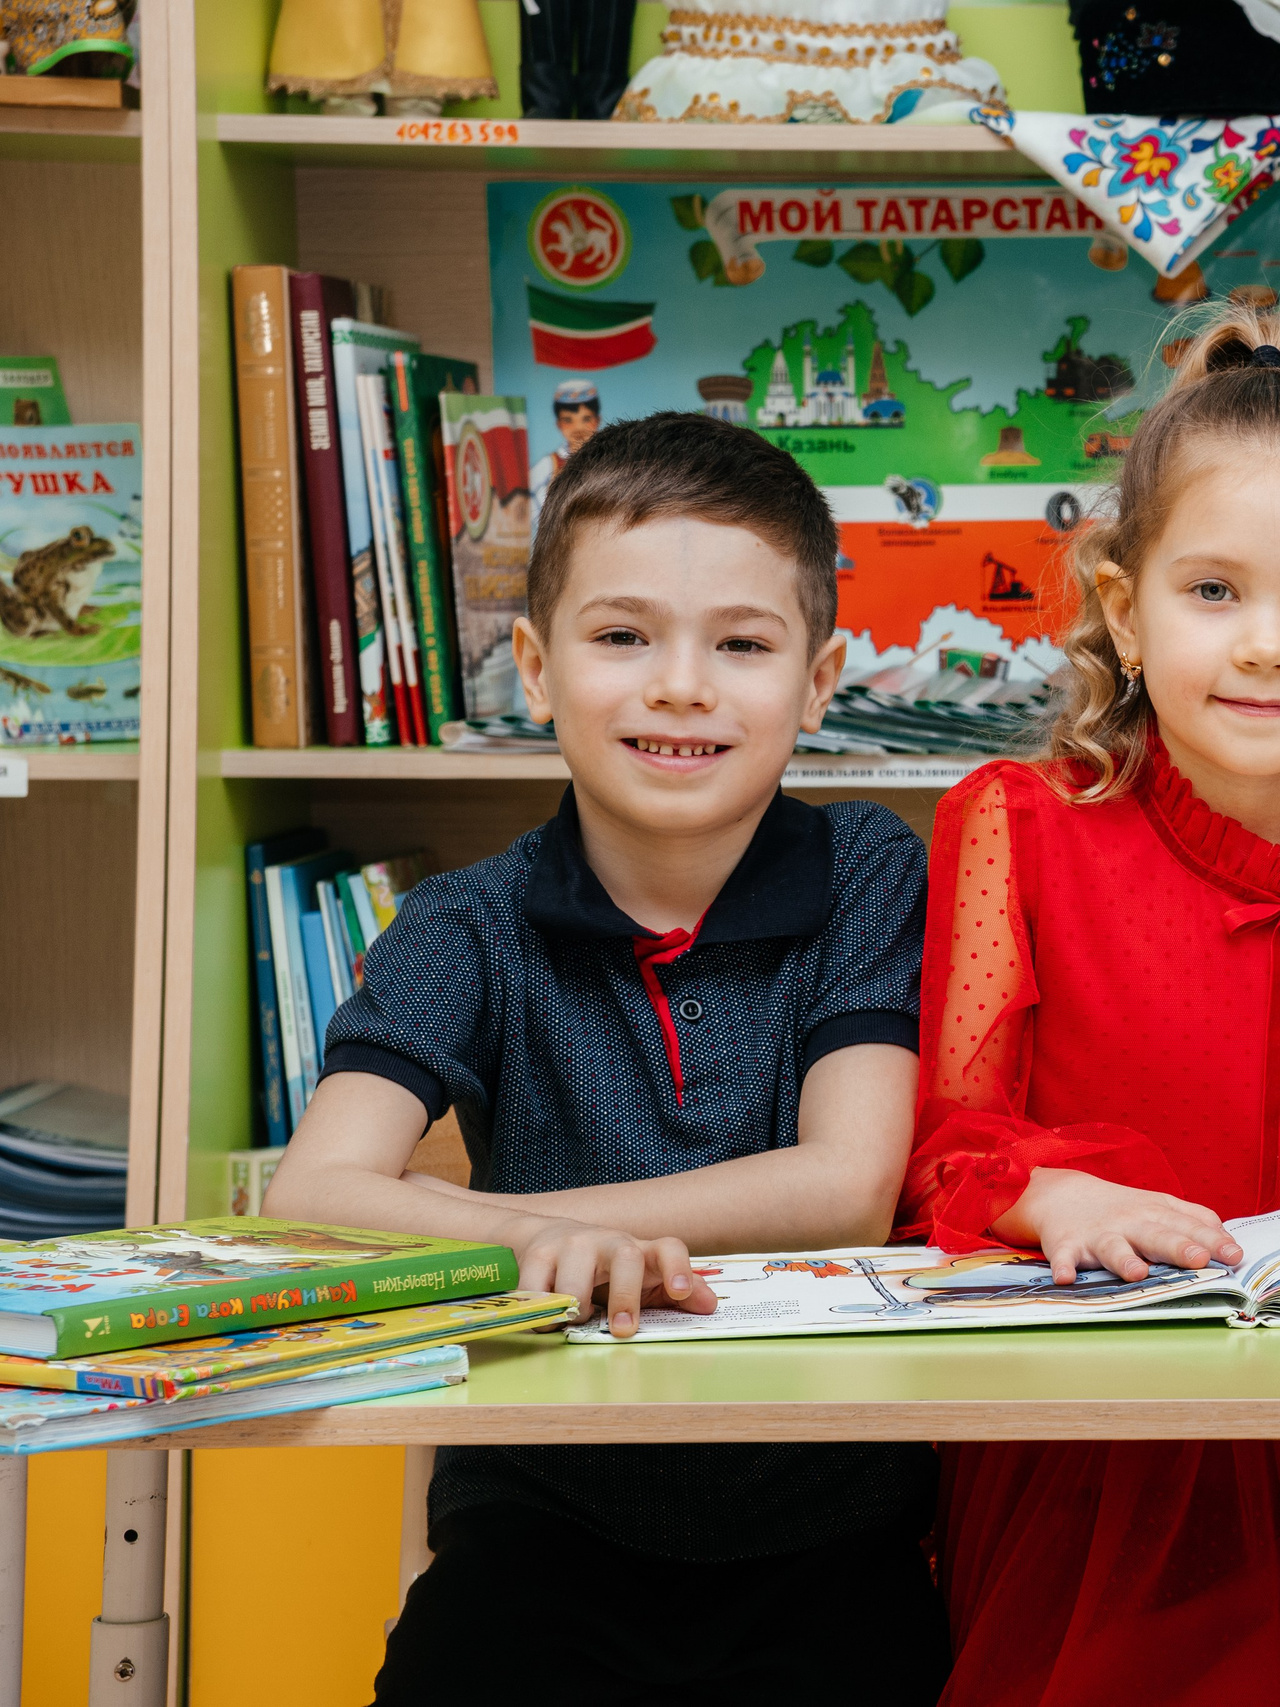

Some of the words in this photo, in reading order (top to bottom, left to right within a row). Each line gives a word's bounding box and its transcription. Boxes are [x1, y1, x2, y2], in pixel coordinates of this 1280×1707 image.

[738, 189, 842, 235] МОЙ
[856, 198, 1105, 234] ТАТАРСТАН
[300, 310, 325, 374] ТАТАРСТАН
[309, 407, 332, 451] ЗЕМЛЯ
[777, 435, 857, 455] Казань
[0, 470, 115, 495] УШКА
[373, 1269, 445, 1295] Наволочкин
[448, 1262, 502, 1287] Николай
[195, 1297, 244, 1320] кота
[250, 1279, 358, 1315] Каникулы
[129, 1303, 190, 1331] Егора
